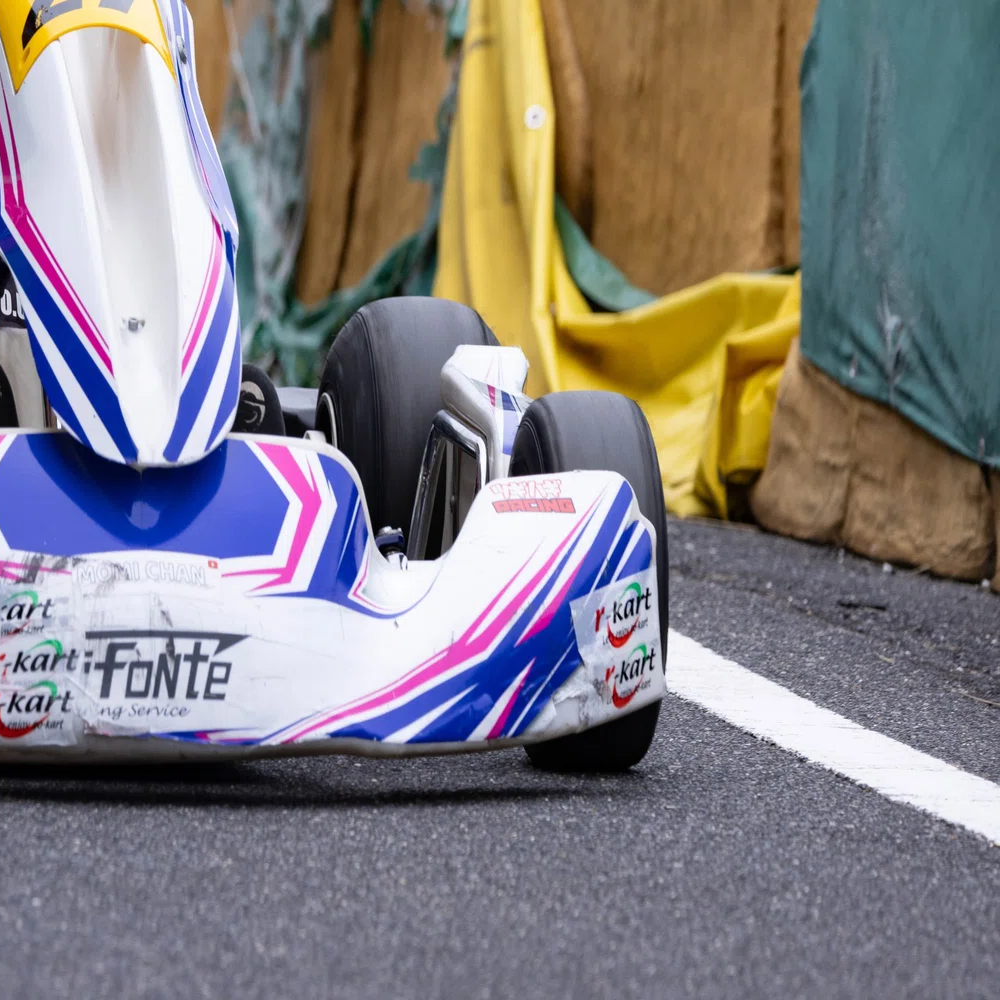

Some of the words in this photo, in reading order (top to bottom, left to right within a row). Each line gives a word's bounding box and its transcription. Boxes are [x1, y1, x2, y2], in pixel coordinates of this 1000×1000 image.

[492, 498, 576, 513] RACING
[77, 560, 140, 584] MOMI
[145, 560, 207, 585] CHAN
[595, 587, 652, 633] r-kart
[605, 647, 657, 684] r-kart
[128, 702, 190, 718] Service
